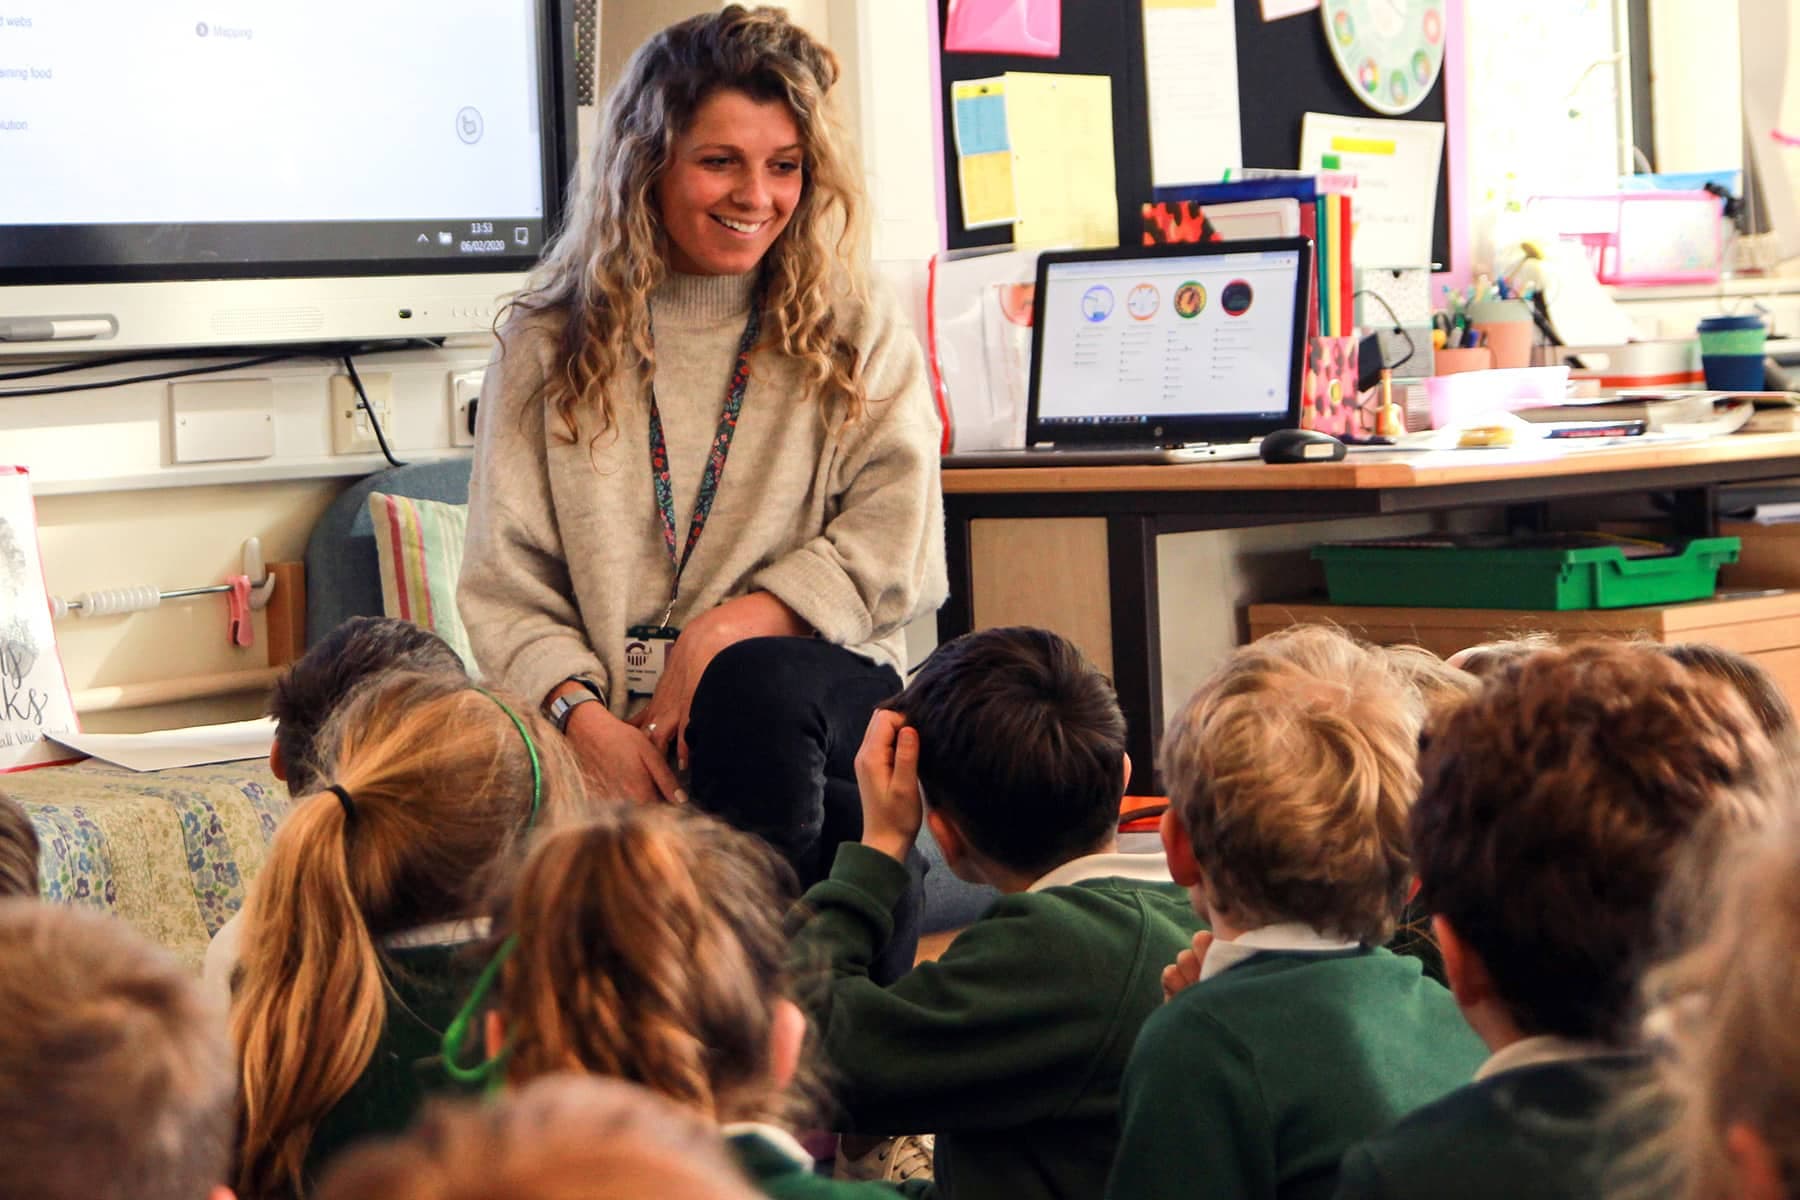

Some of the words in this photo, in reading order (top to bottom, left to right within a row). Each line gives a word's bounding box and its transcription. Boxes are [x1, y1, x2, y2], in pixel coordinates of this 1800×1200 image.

[30, 66, 52, 79] food
[471, 222, 494, 233] 13:53
[460, 240, 505, 252] 06/02/2020
